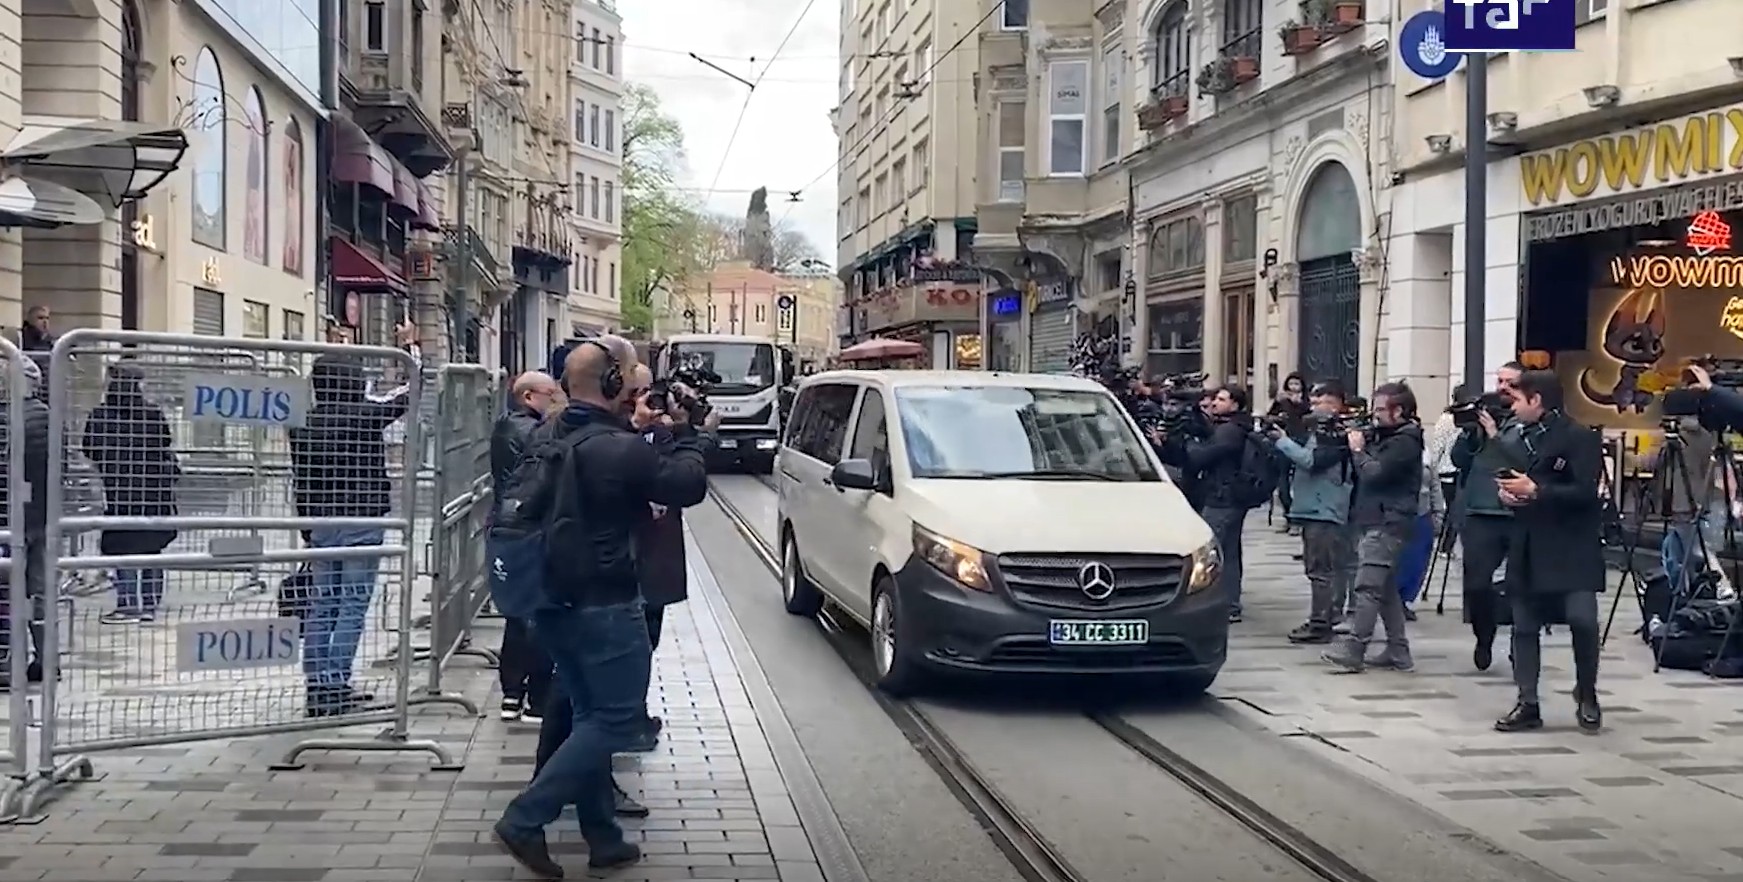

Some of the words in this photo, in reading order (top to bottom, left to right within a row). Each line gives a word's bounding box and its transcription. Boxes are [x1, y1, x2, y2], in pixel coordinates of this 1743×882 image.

[926, 288, 980, 307] KO
[193, 386, 291, 422] POLİS
[196, 624, 293, 662] POLİS
[1062, 624, 1080, 641] 34
[1085, 624, 1104, 641] CC
[1109, 624, 1143, 641] 3311
